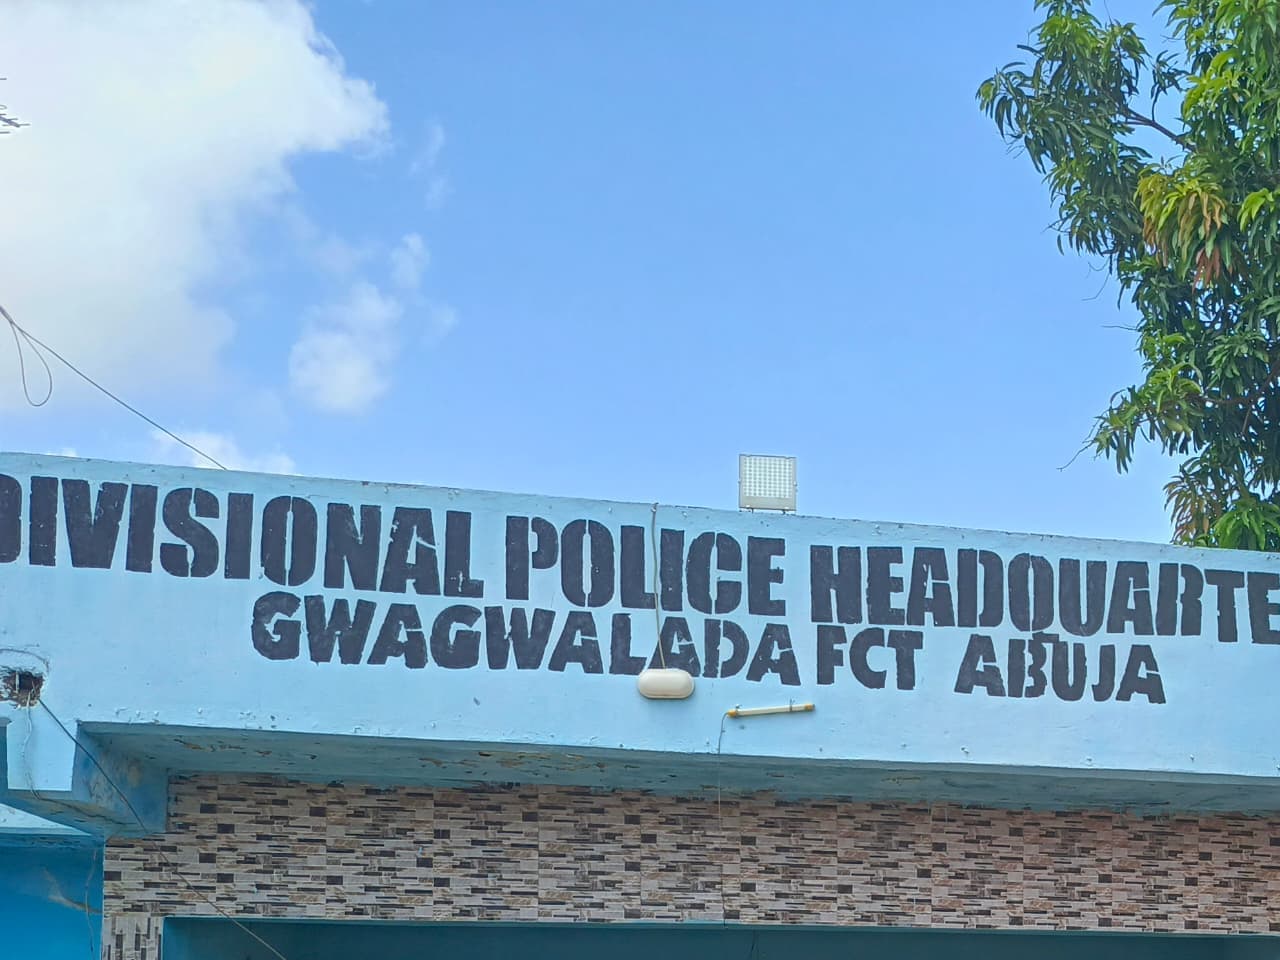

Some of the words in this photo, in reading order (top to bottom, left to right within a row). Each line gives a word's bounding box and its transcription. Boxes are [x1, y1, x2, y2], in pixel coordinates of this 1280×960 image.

[505, 515, 786, 616] POLICE
[251, 591, 801, 686] GWAGWALADA
[816, 625, 924, 691] FCT
[954, 632, 1167, 705] ABUJA
